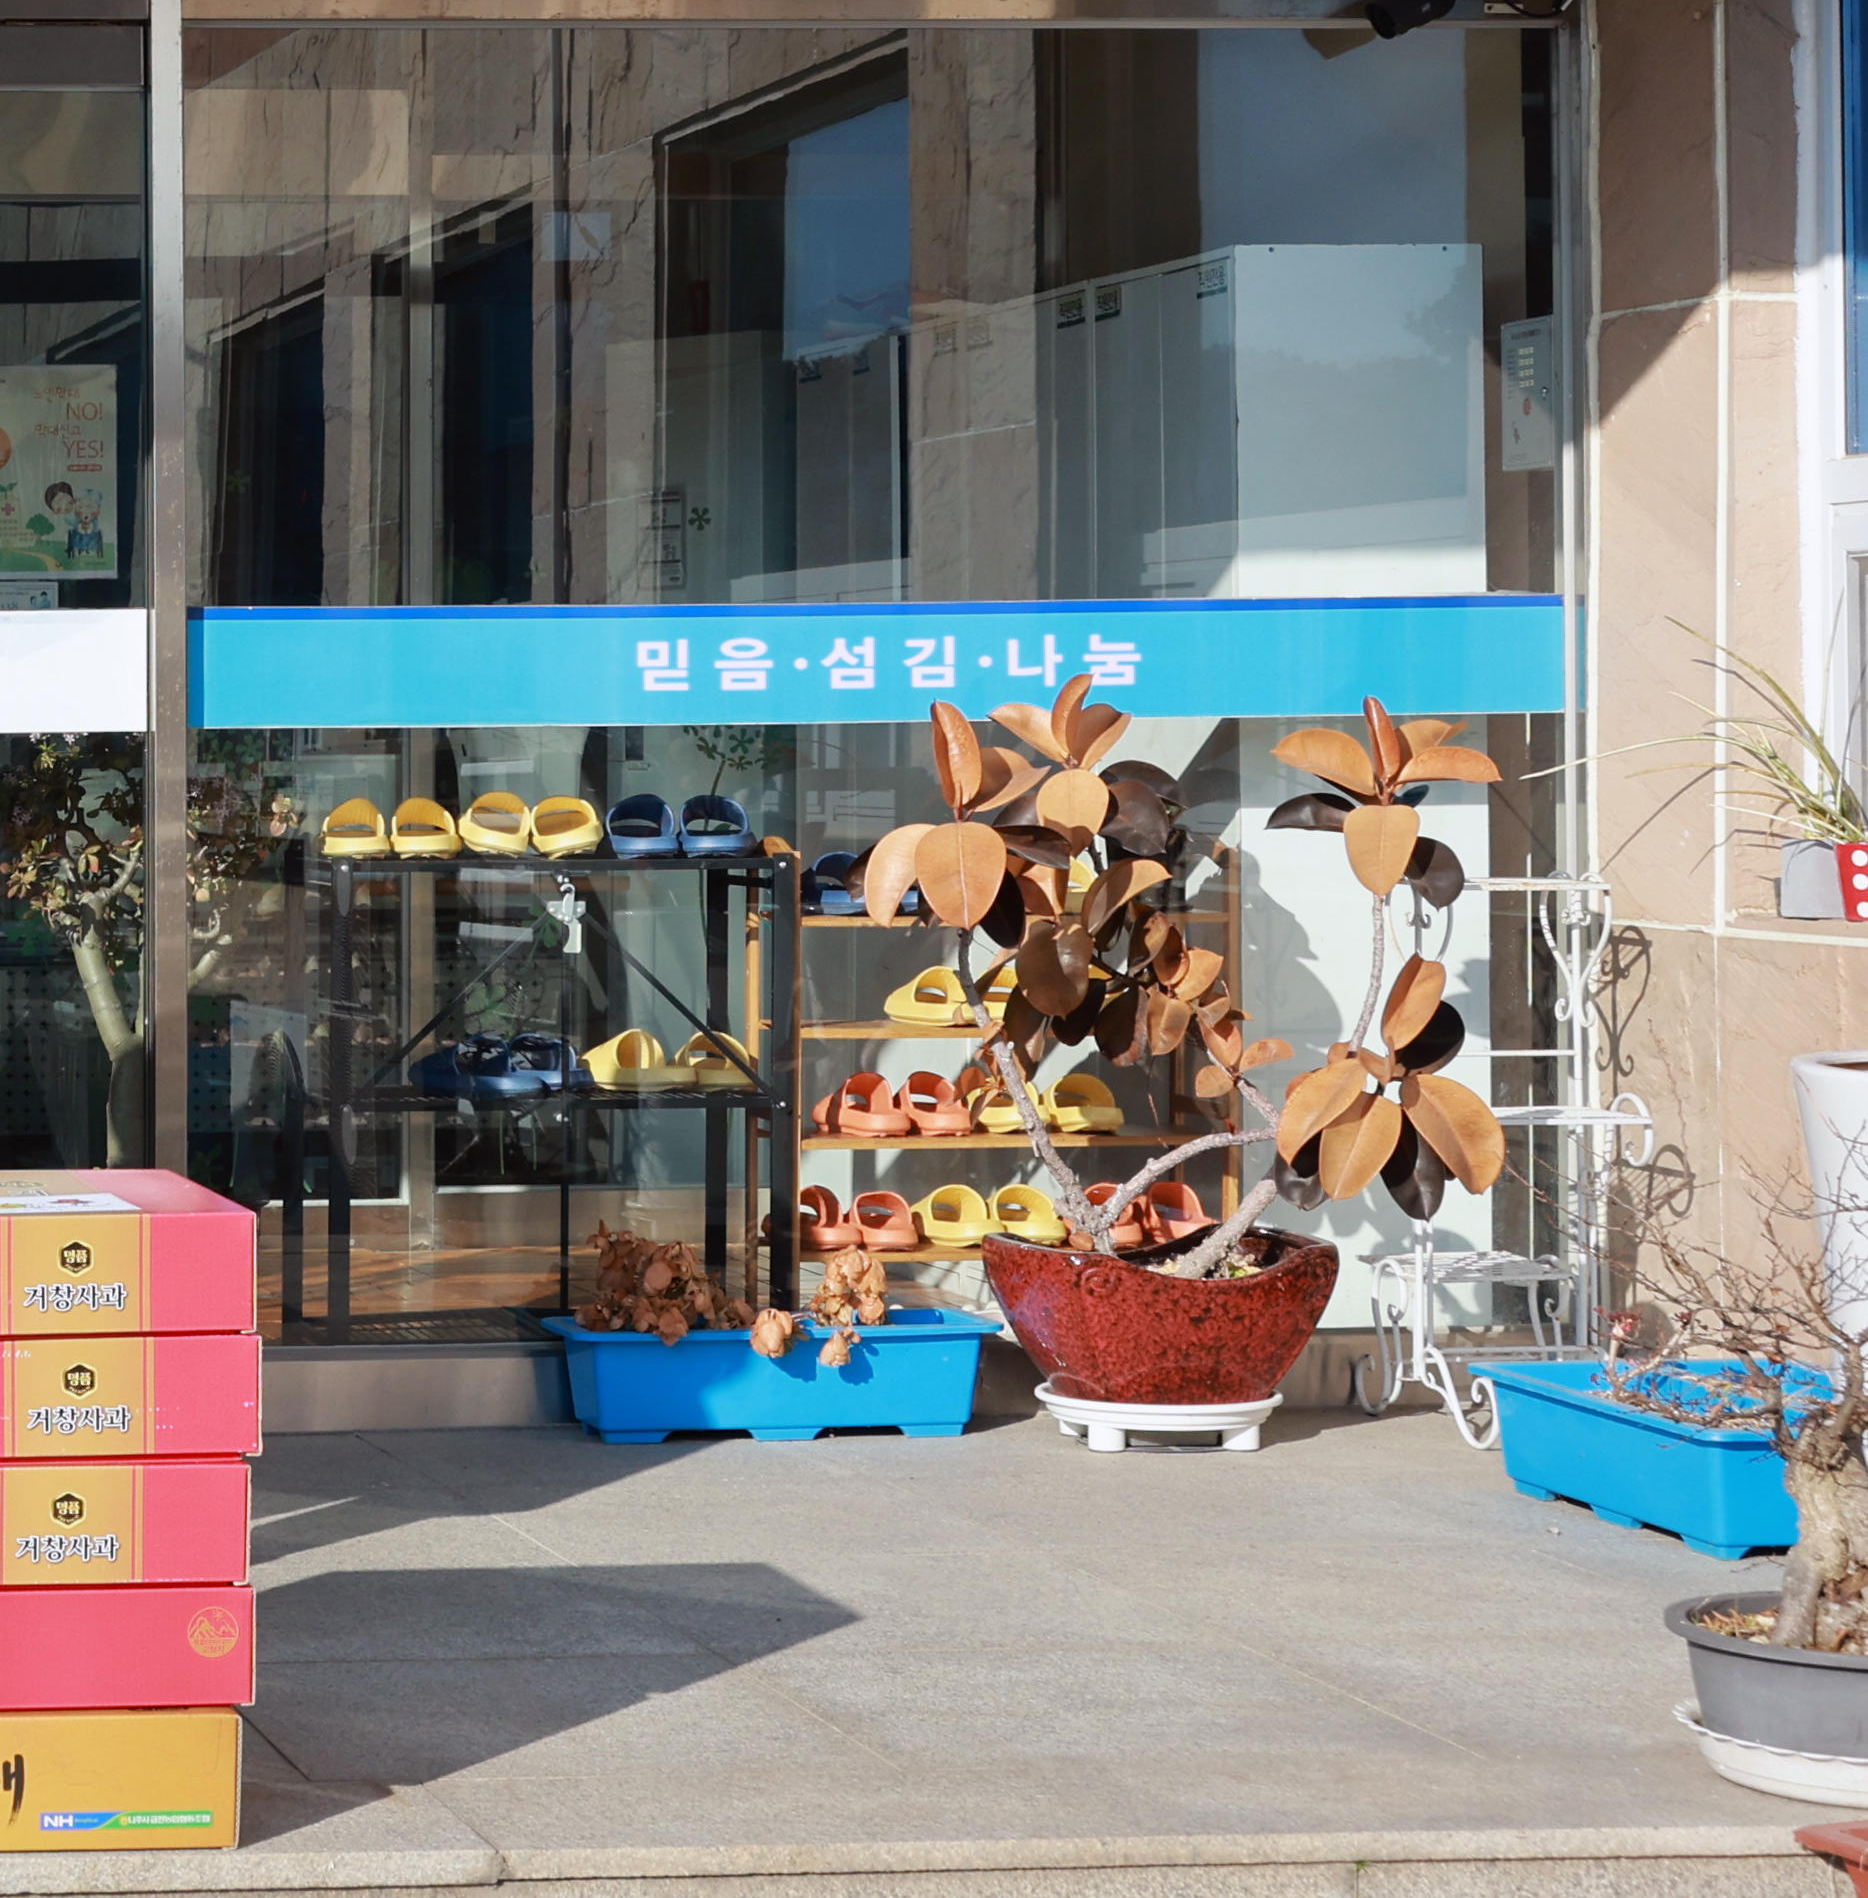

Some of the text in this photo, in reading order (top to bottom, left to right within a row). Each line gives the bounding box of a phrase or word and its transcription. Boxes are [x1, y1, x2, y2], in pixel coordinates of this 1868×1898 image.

[66, 402, 103, 421] NO!
[62, 440, 104, 459] YES!
[636, 634, 1142, 691] 믿음·섬김·나눔
[63, 1249, 88, 1264] 명품
[23, 1282, 129, 1313] 거창사과
[67, 1371, 92, 1387] 명품
[27, 1405, 132, 1434] 거창사과
[56, 1500, 81, 1516] 명품
[14, 1534, 120, 1564] 거창사과
[43, 1814, 74, 1828] NH
